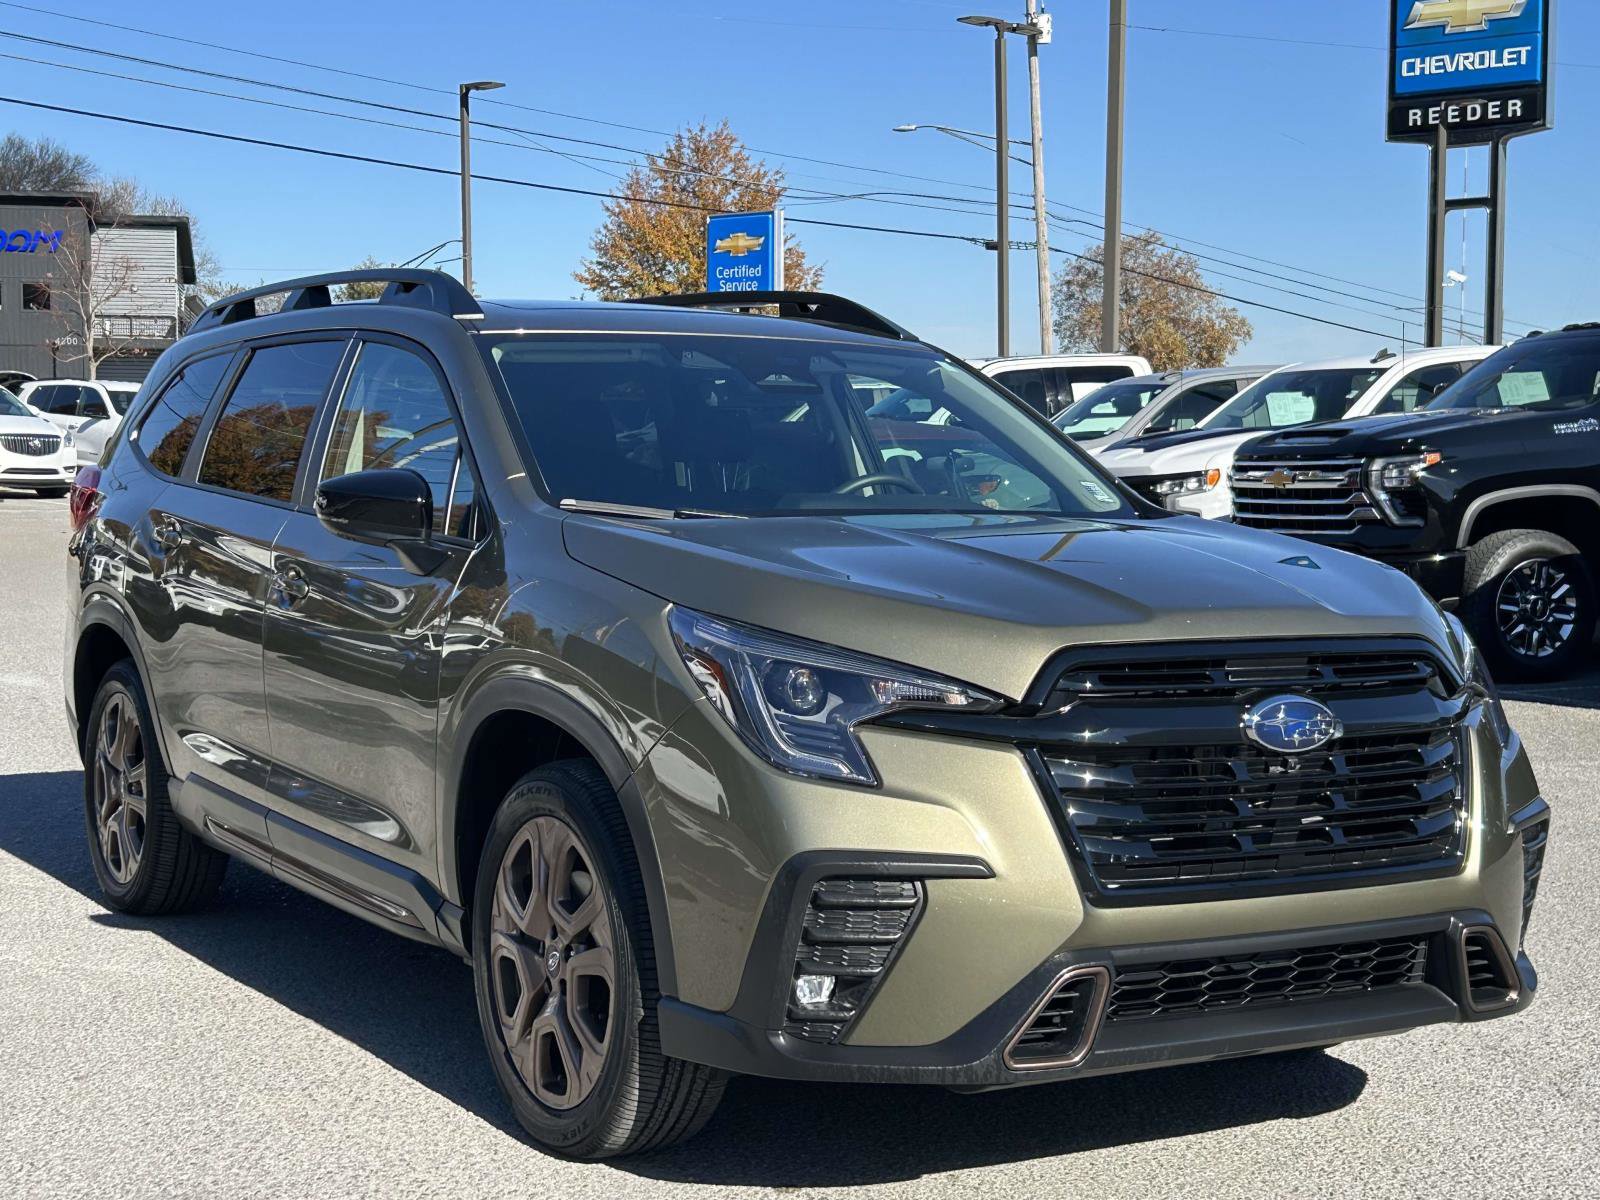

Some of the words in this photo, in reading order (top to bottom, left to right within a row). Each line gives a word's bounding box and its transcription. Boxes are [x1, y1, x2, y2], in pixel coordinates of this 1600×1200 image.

[1401, 46, 1531, 77] CHEVROLET
[1408, 100, 1522, 126] REEDER
[716, 264, 762, 278] Certified
[720, 279, 758, 291] Service
